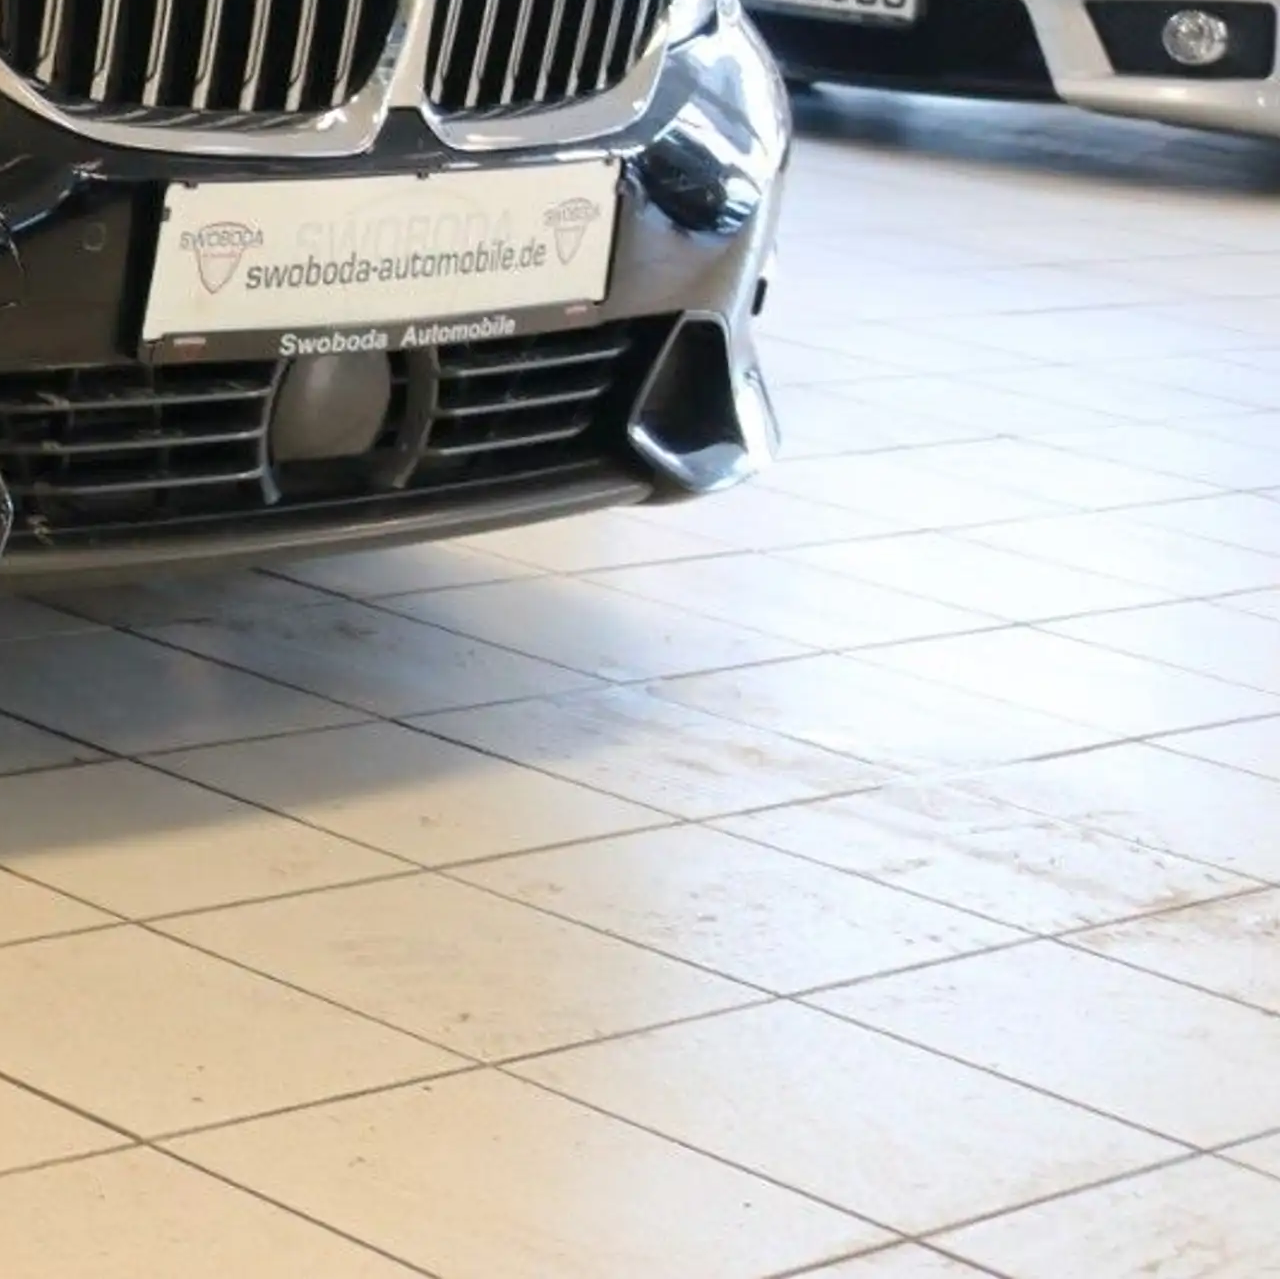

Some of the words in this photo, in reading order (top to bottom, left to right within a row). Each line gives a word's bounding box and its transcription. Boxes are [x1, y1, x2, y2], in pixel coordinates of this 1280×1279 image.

[245, 237, 547, 290] swoboda-automobile.de
[279, 329, 390, 356] Swoboda
[399, 314, 516, 348] Automobile
